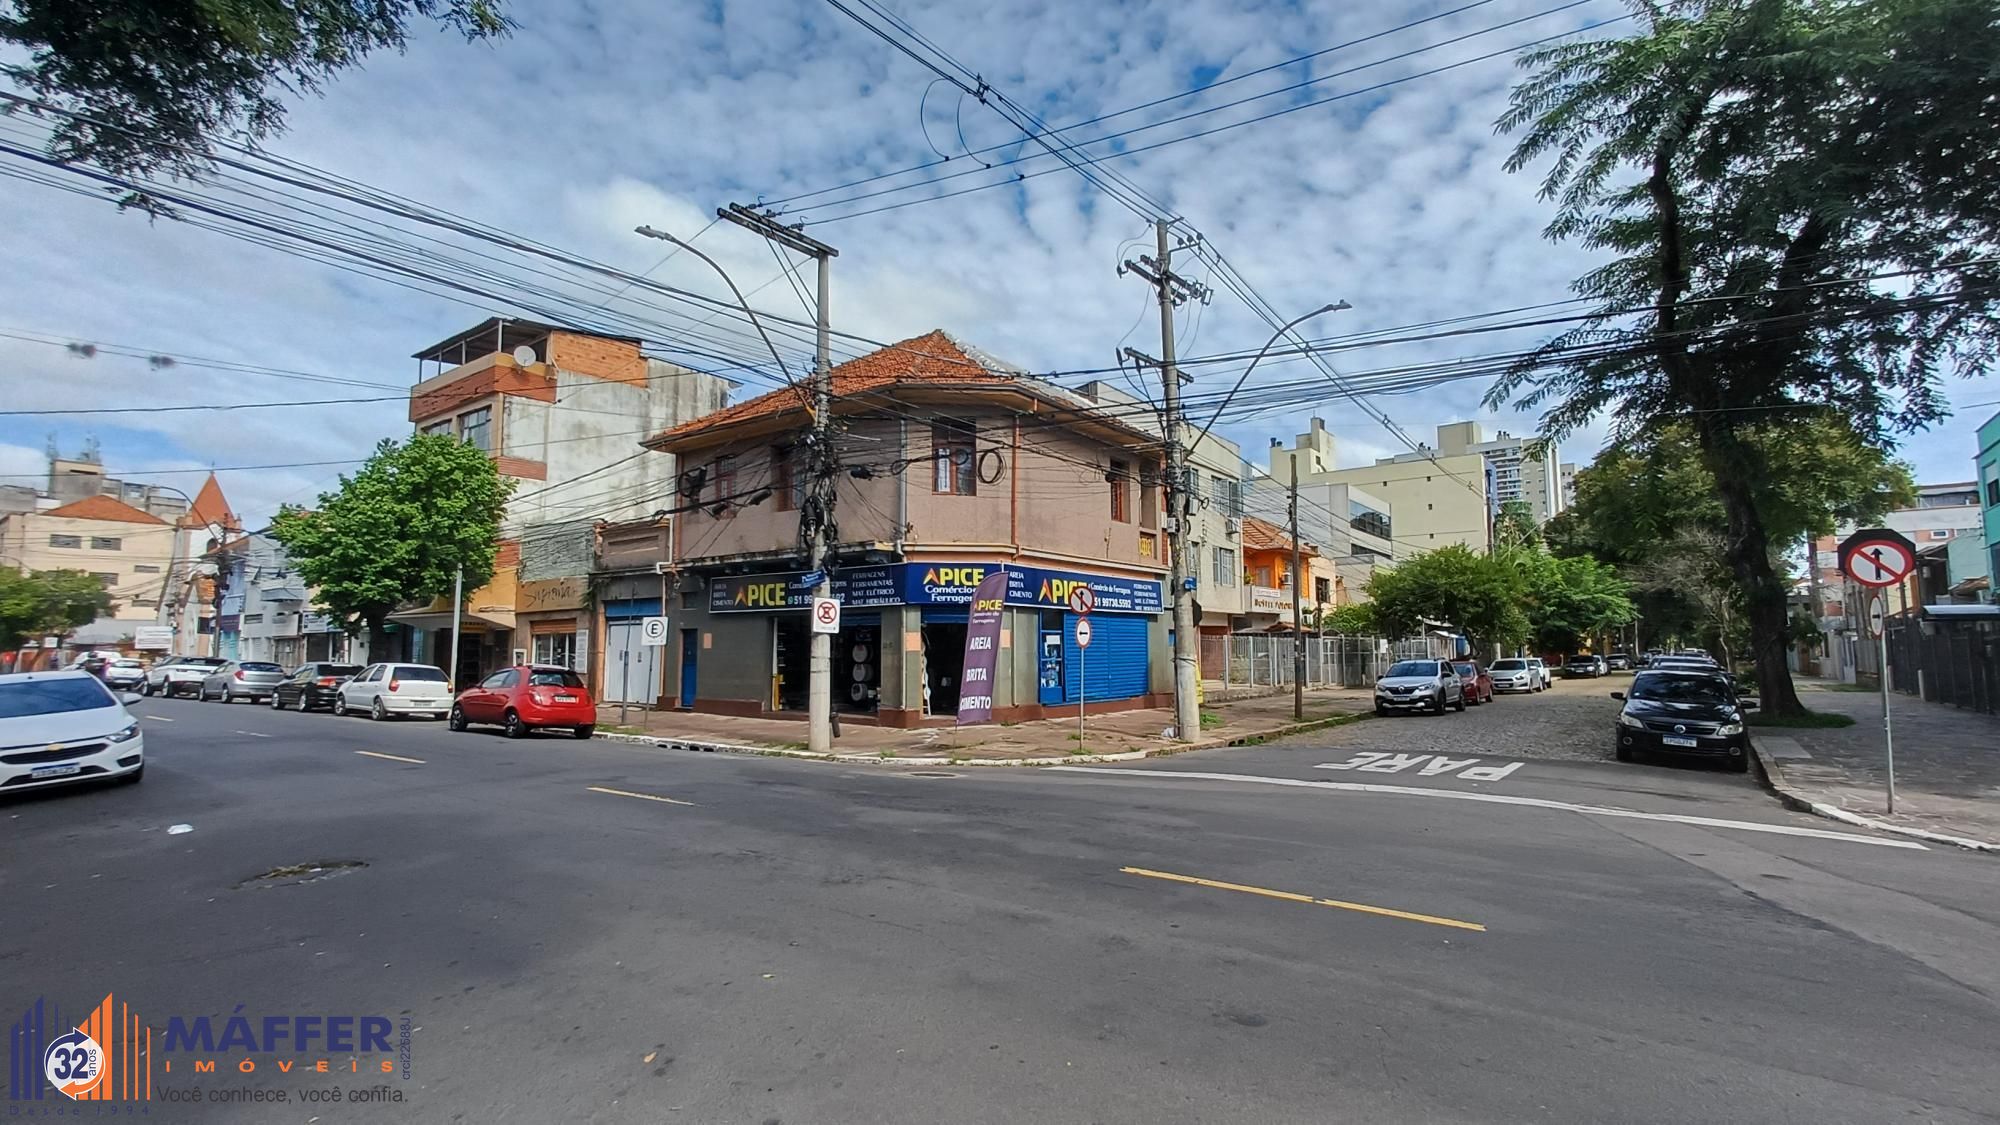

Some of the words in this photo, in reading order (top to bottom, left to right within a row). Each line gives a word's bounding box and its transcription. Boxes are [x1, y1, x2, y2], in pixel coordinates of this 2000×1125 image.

[923, 567, 985, 586] APICE
[1009, 571, 1024, 579] AREIA
[925, 585, 972, 594] Comércio
[1009, 580, 1024, 588] BRITA
[1091, 582, 1109, 591] Comércio
[734, 582, 786, 608] APICE
[1009, 590, 1033, 598] CIMENTO
[794, 595, 802, 605] 51
[1094, 596, 1101, 606] 51
[651, 623, 659, 635] E
[969, 636, 992, 651] AREIA
[966, 667, 988, 682] BRITA
[959, 695, 992, 710] CIMENTO
[1312, 752, 1526, 782] PARE
